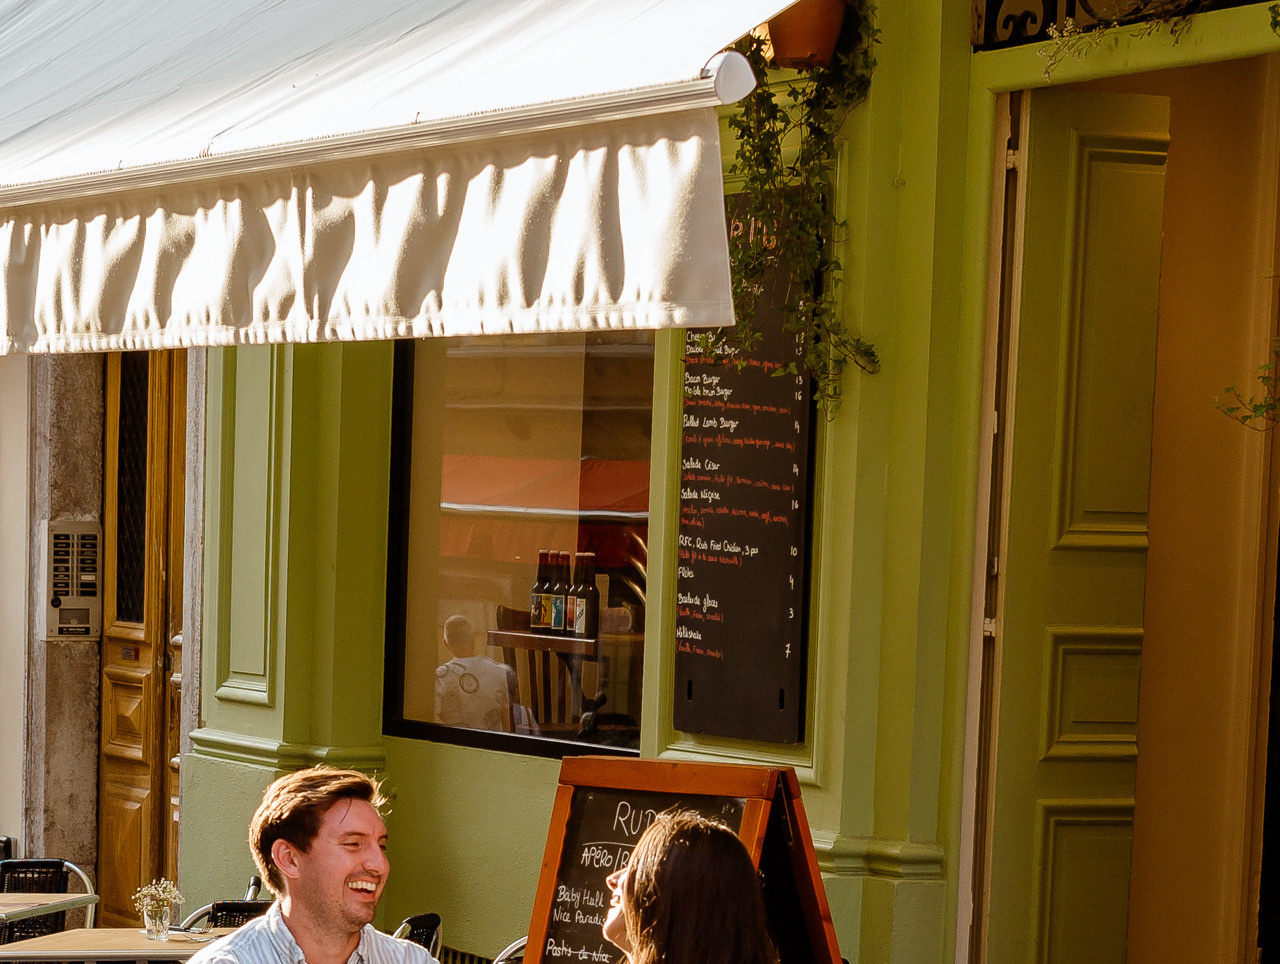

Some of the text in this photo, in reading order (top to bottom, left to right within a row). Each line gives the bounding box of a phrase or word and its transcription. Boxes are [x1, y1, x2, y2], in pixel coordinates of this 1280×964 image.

[795, 375, 803, 385] 13
[794, 391, 802, 401] 16
[682, 457, 702, 470] Salade
[680, 487, 699, 500] Salade
[791, 499, 799, 511] 16
[745, 545, 750, 556] 3
[790, 545, 798, 557] 10
[789, 574, 794, 590] 4
[788, 607, 795, 619] 3
[785, 643, 791, 659] 7
[557, 885, 604, 908] Baby Hulk
[553, 906, 572, 923] Nice
[545, 938, 572, 957] Pastis
[591, 944, 613, 964] Nice
